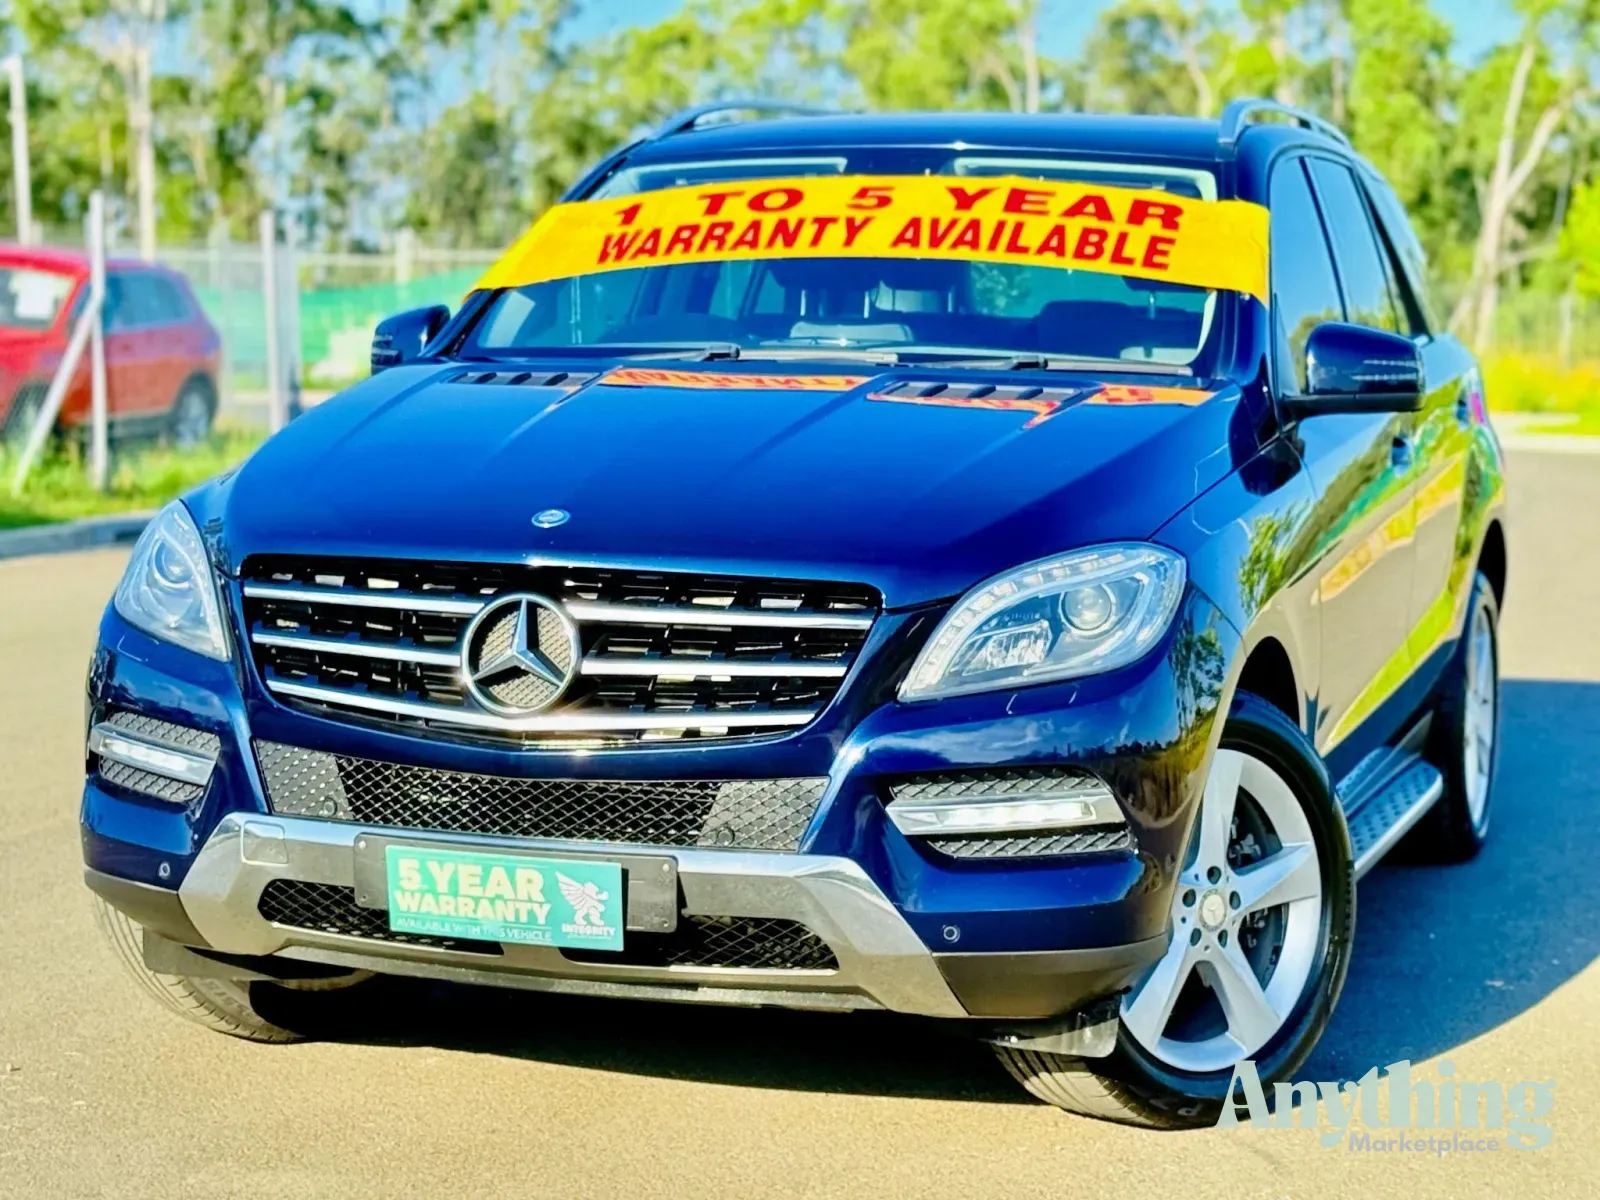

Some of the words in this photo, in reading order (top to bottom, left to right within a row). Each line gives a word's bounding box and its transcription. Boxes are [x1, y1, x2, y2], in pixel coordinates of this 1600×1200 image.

[614, 203, 645, 226] 1
[697, 188, 805, 217] TO
[846, 186, 895, 211] 5
[945, 186, 1184, 231] YEAR
[596, 215, 875, 266] WARRANTY
[890, 216, 1177, 271] AVAILABLE
[398, 858, 423, 891] 5
[426, 862, 545, 903] YEAR
[394, 890, 551, 925] WARRANTY
[396, 918, 451, 933] AVAILABLE
[451, 923, 480, 935] WITH
[483, 925, 505, 938] THIS
[506, 928, 553, 941] VEHICLE
[561, 923, 616, 937] INTEGRITY
